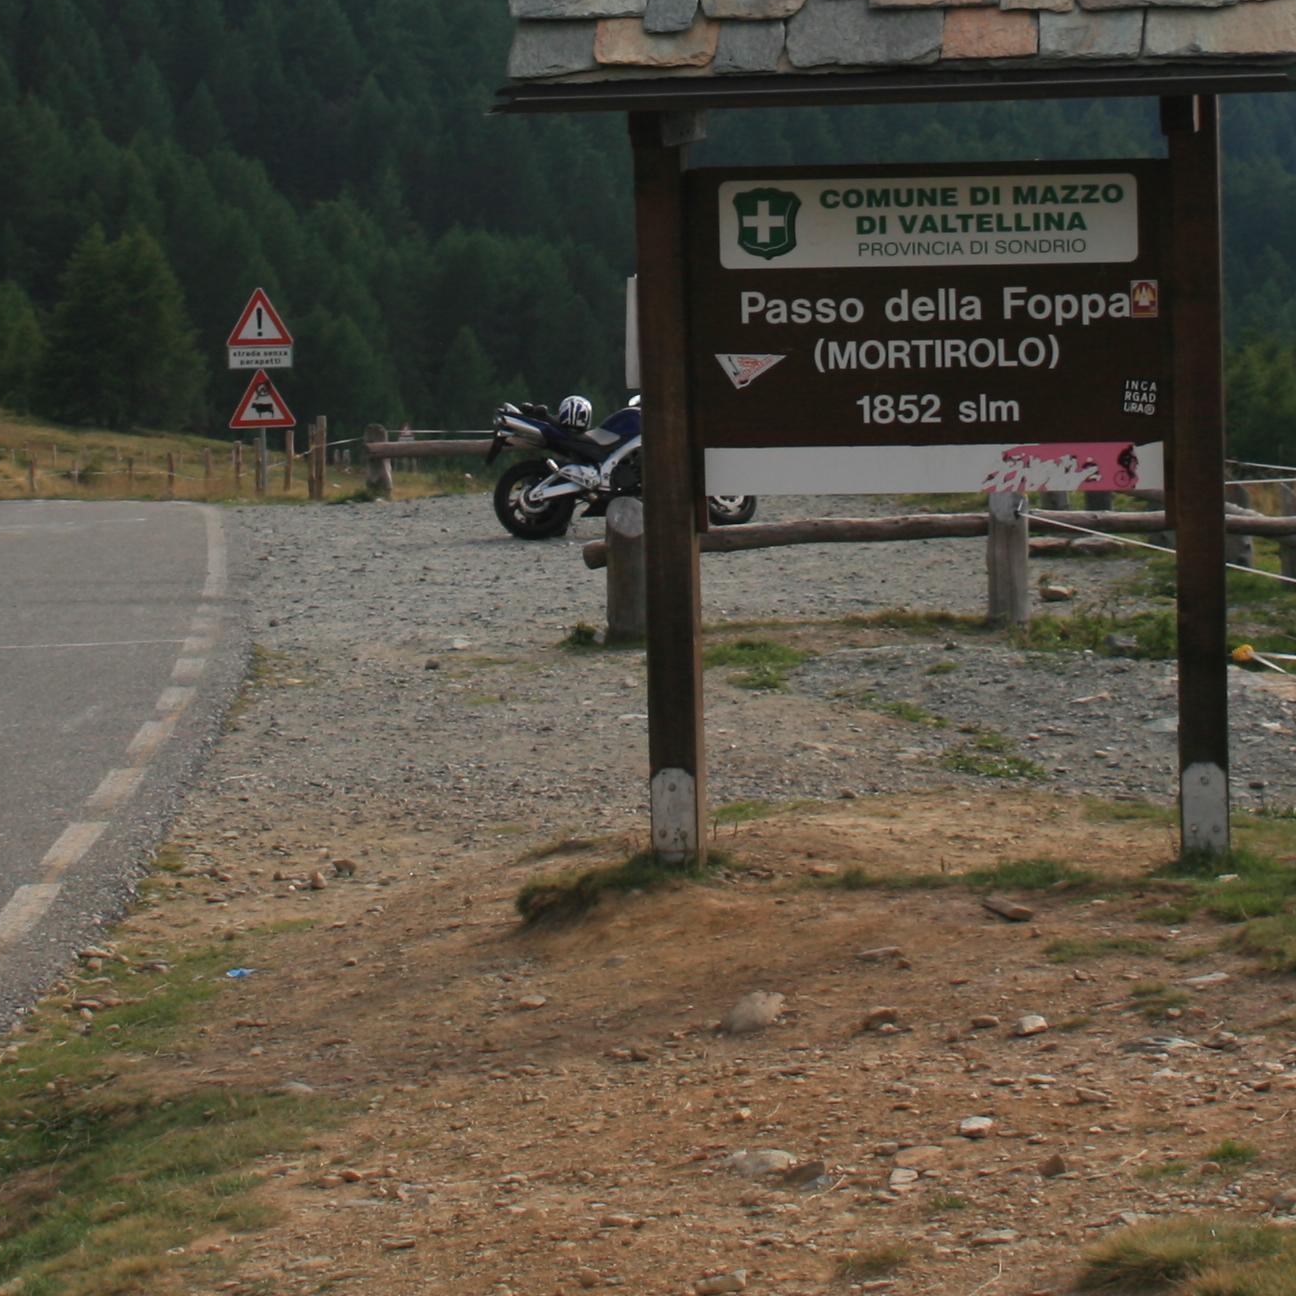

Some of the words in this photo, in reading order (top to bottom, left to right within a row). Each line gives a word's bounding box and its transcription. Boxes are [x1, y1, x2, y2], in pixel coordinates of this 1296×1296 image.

[819, 188, 959, 210] COMUNE
[968, 186, 1001, 207] DI
[1011, 183, 1125, 206] MAZZO
[855, 215, 887, 236] DI
[898, 212, 1088, 234] VALTELLINA
[857, 241, 964, 257] PROVINCIA
[970, 240, 989, 255] DI
[995, 238, 1087, 255] SONDRIO
[740, 291, 865, 324] Passo
[885, 289, 981, 322] della
[1003, 287, 1131, 326] Foppa
[813, 335, 1059, 373] (MORTIROLO)
[1124, 391, 1156, 403] RGAD
[1125, 380, 1157, 391] INCA
[856, 395, 942, 424] 1852
[958, 394, 1020, 423] slm
